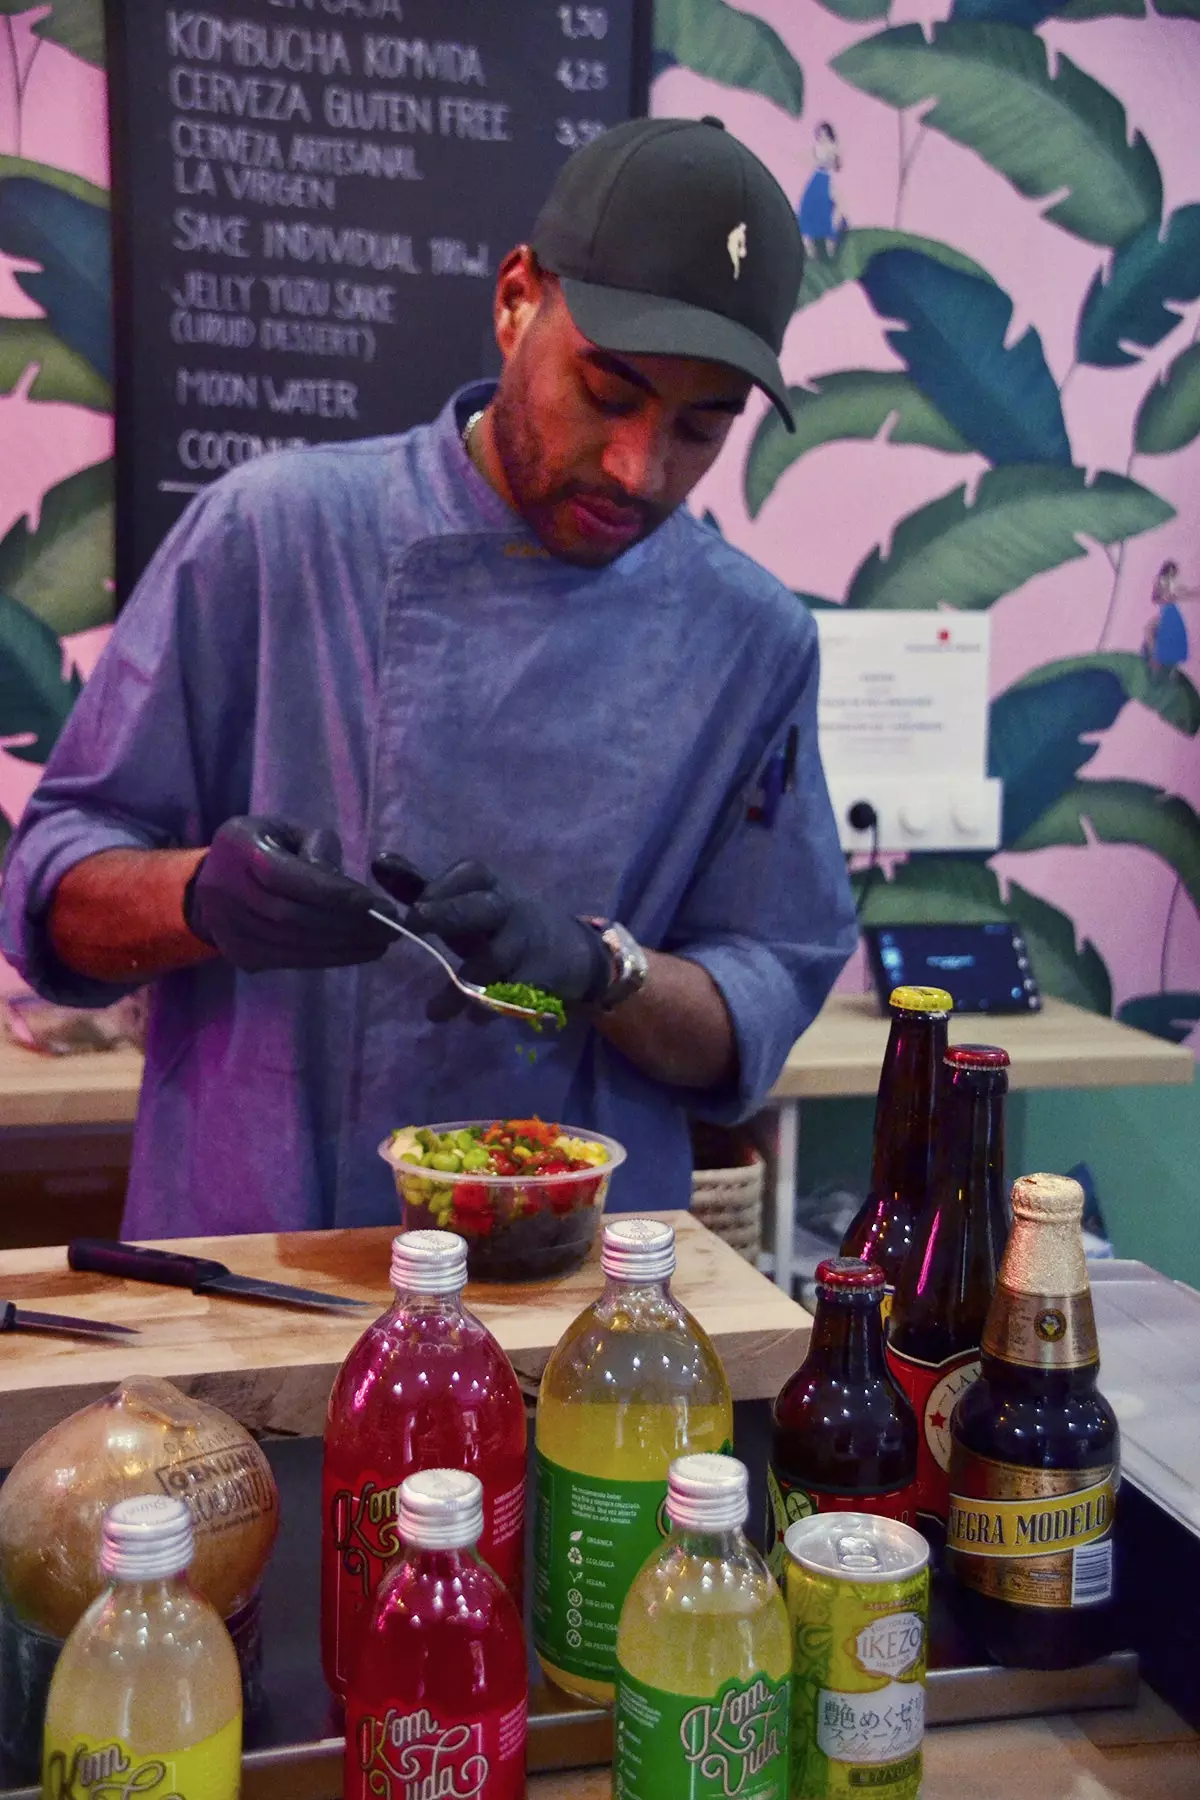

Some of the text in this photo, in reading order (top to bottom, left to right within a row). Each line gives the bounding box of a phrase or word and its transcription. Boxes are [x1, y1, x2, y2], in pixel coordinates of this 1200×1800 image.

[166, 9, 486, 88] KOMBUCHA KOMVIDA
[169, 66, 511, 141] CERVEZA GLUTEN FREE
[171, 120, 424, 180] CERVEZA ARTESANAL
[173, 161, 336, 209] LA VIRGEN
[172, 207, 250, 258] SAKE
[261, 220, 422, 275] INDIVIDUAL
[170, 271, 397, 325] JELLY YUZU SAKE
[175, 367, 359, 420] MOON WATER
[1015, 1493, 1109, 1547] MODELO
[861, 1626, 921, 1659] IKEZO
